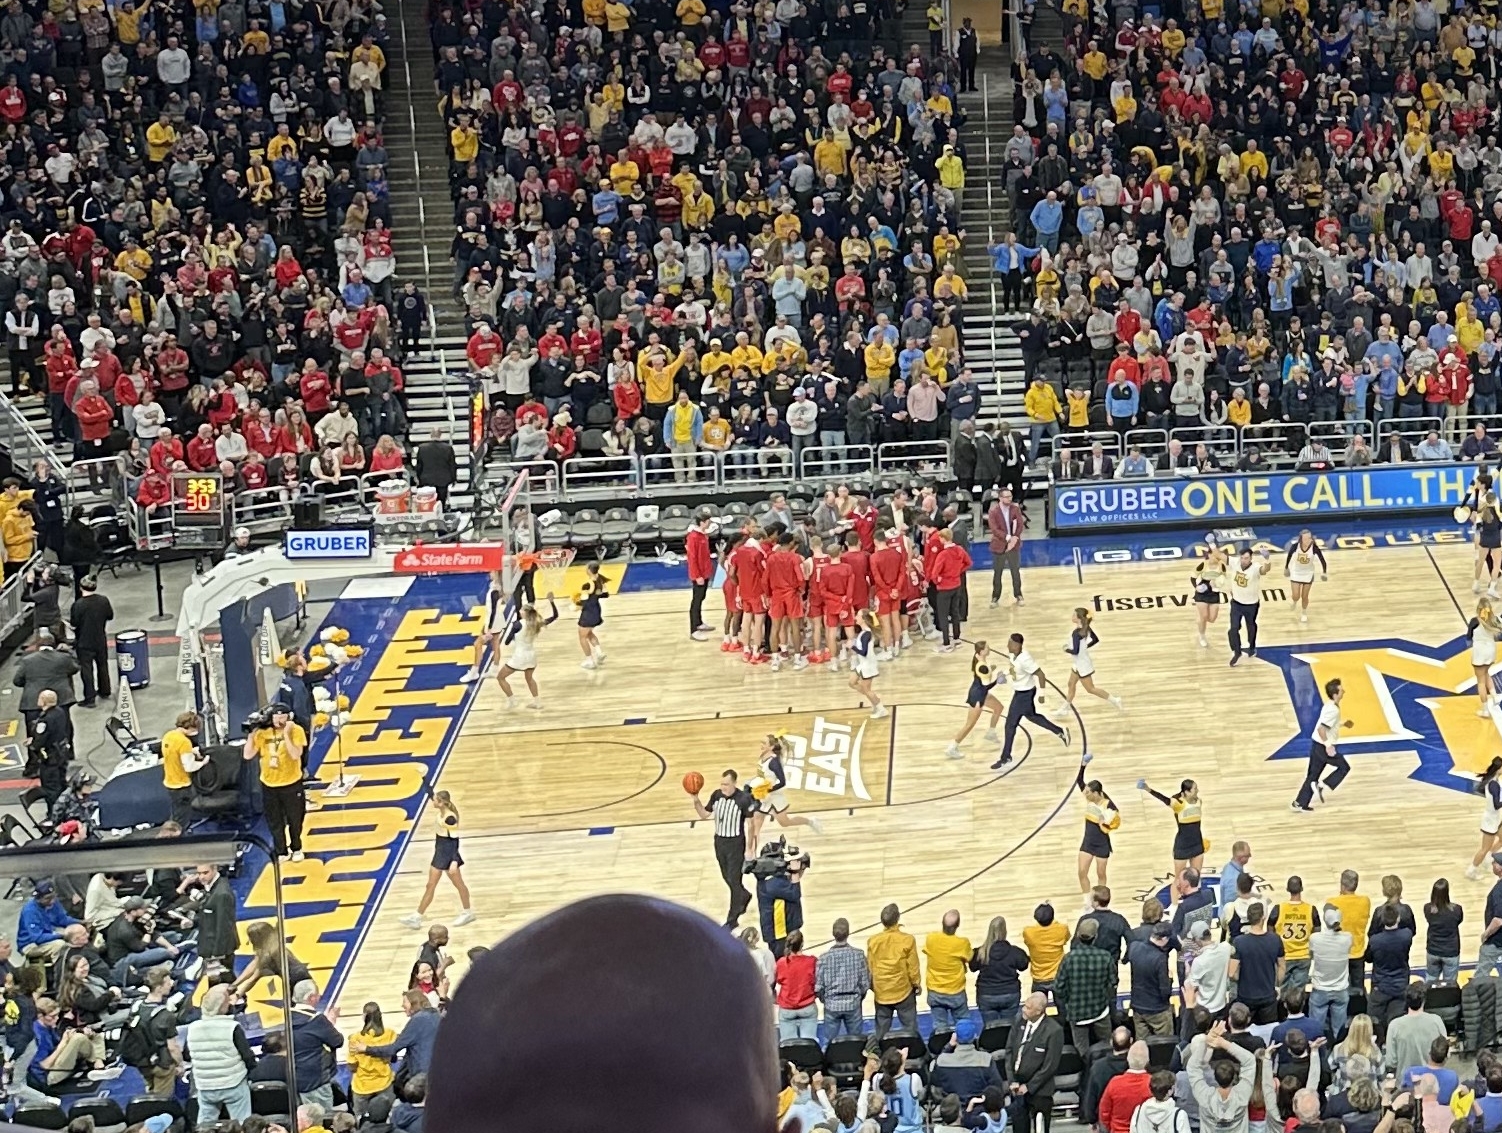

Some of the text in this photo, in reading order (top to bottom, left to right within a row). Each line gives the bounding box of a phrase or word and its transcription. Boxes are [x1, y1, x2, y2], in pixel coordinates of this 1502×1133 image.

[187, 494, 210, 511] 30
[1058, 486, 1177, 514] GRUBER
[1181, 479, 1272, 516] ONE
[1078, 511, 1159, 523] LAW OFFICES LLC
[290, 536, 367, 552] GRUBER
[805, 716, 852, 796] EAST
[1282, 923, 1308, 940] 33
